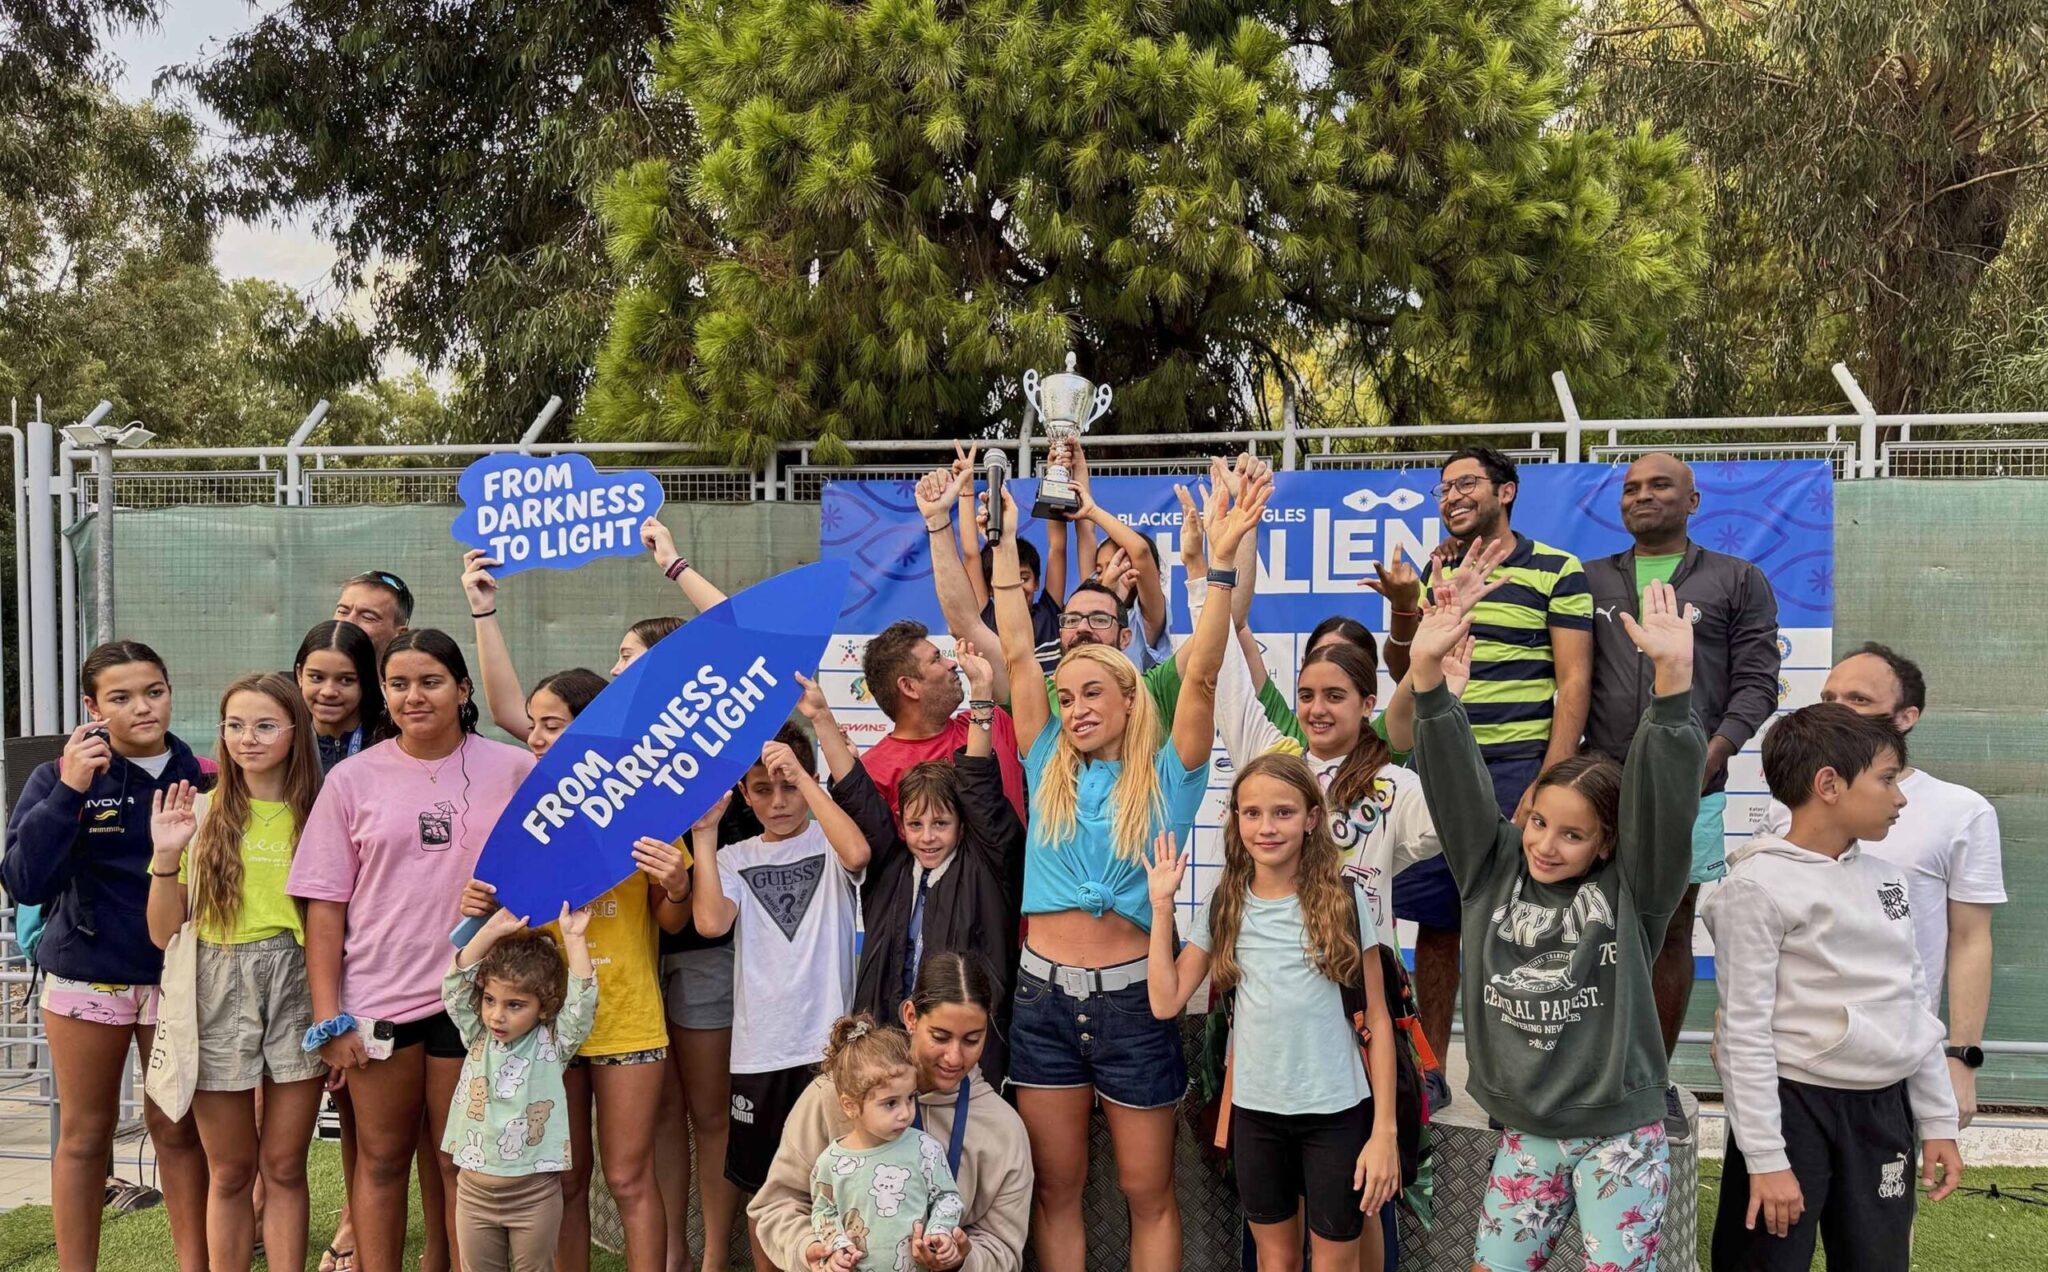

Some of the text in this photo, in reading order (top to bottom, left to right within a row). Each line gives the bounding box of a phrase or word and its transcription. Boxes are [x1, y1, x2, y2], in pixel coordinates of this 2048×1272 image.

[484, 462, 573, 501] FROM
[477, 482, 645, 535] DARKNESS
[1262, 508, 1306, 523] GLES
[489, 517, 637, 564] TO LIGHT
[580, 665, 727, 828] DARKNESS
[652, 655, 778, 795] TO LIGHT
[840, 723, 887, 732] SWANS
[522, 749, 614, 845] FROM
[1539, 999, 1570, 1021] PAR
[731, 1105, 754, 1124] PUMA
